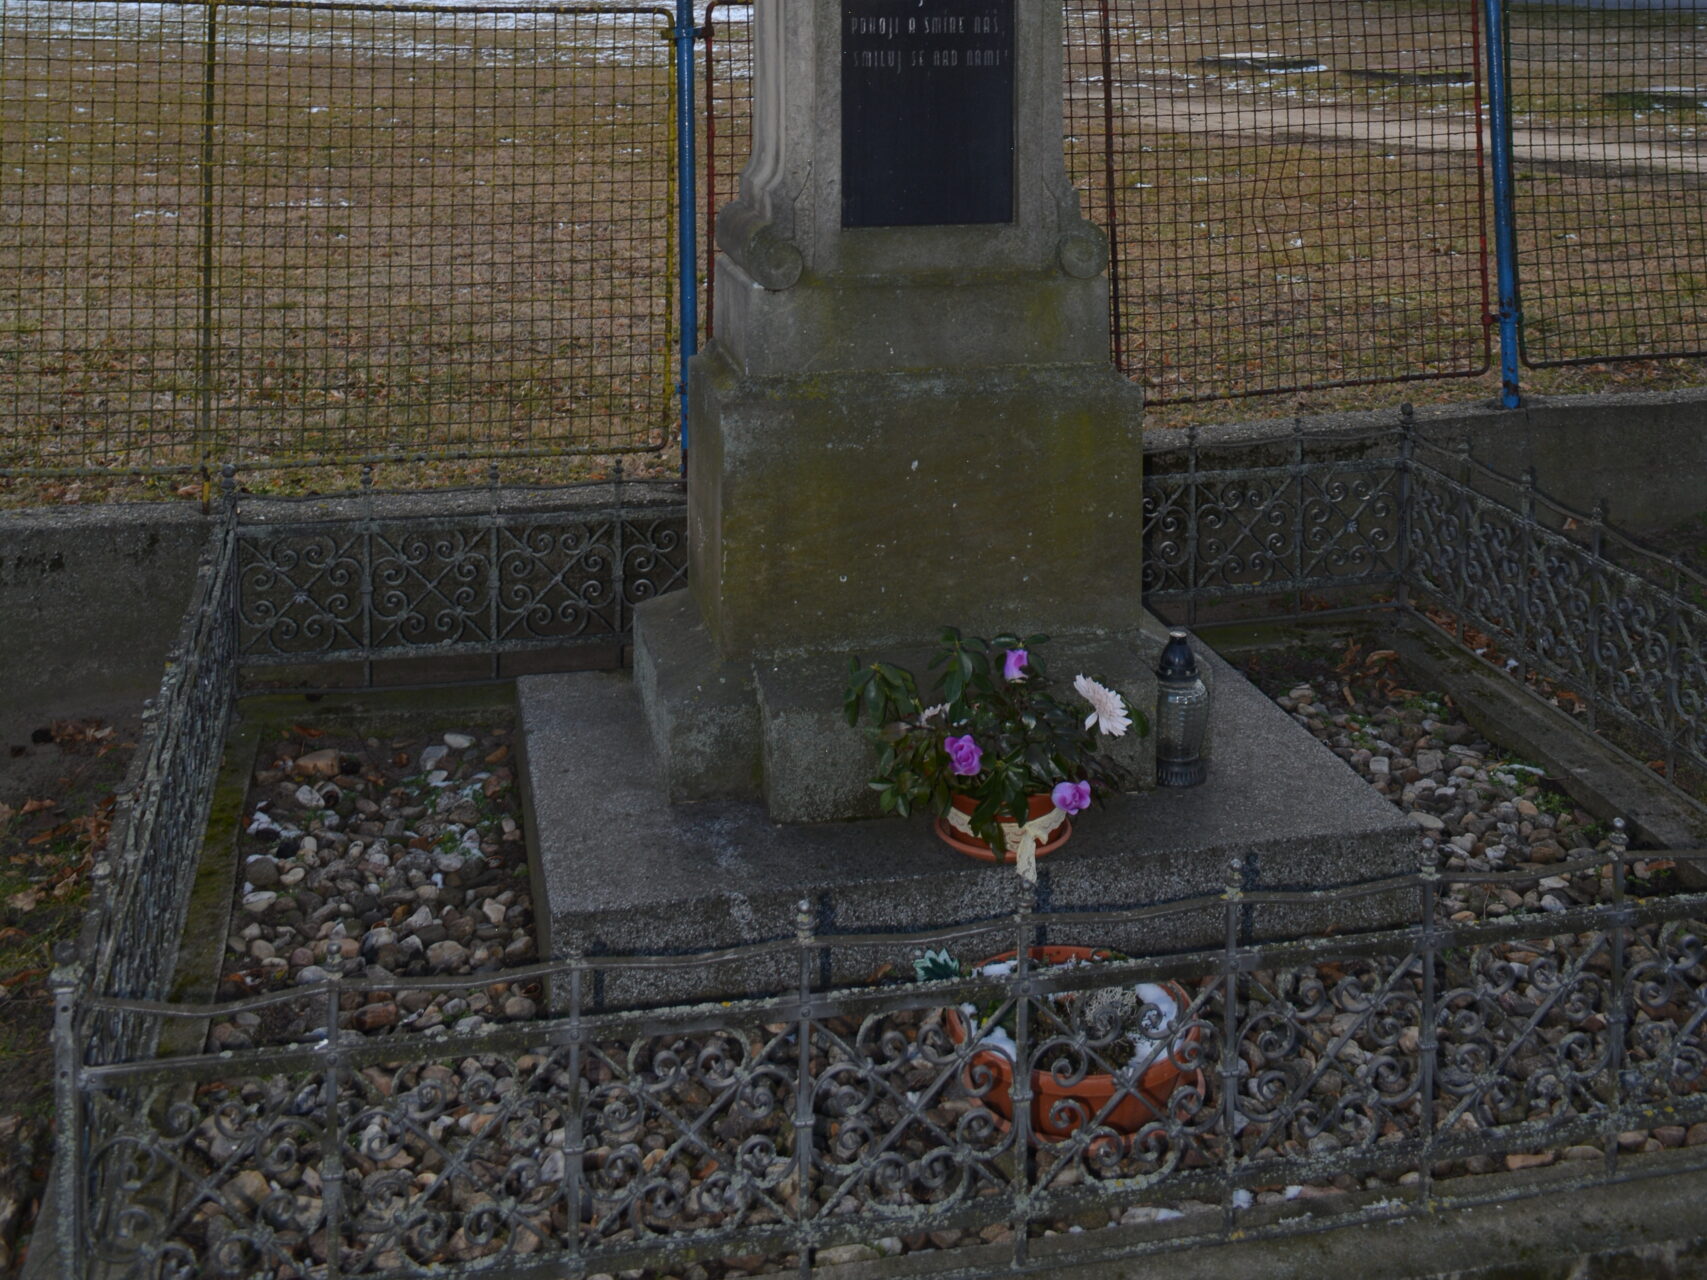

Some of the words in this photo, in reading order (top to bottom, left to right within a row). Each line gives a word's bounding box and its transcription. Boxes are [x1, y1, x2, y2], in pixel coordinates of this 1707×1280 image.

[851, 15, 899, 40] POKOJI
[908, 15, 916, 34] A
[853, 49, 902, 75] SMILUJ
[911, 49, 926, 66] SE
[932, 50, 958, 66] NAD
